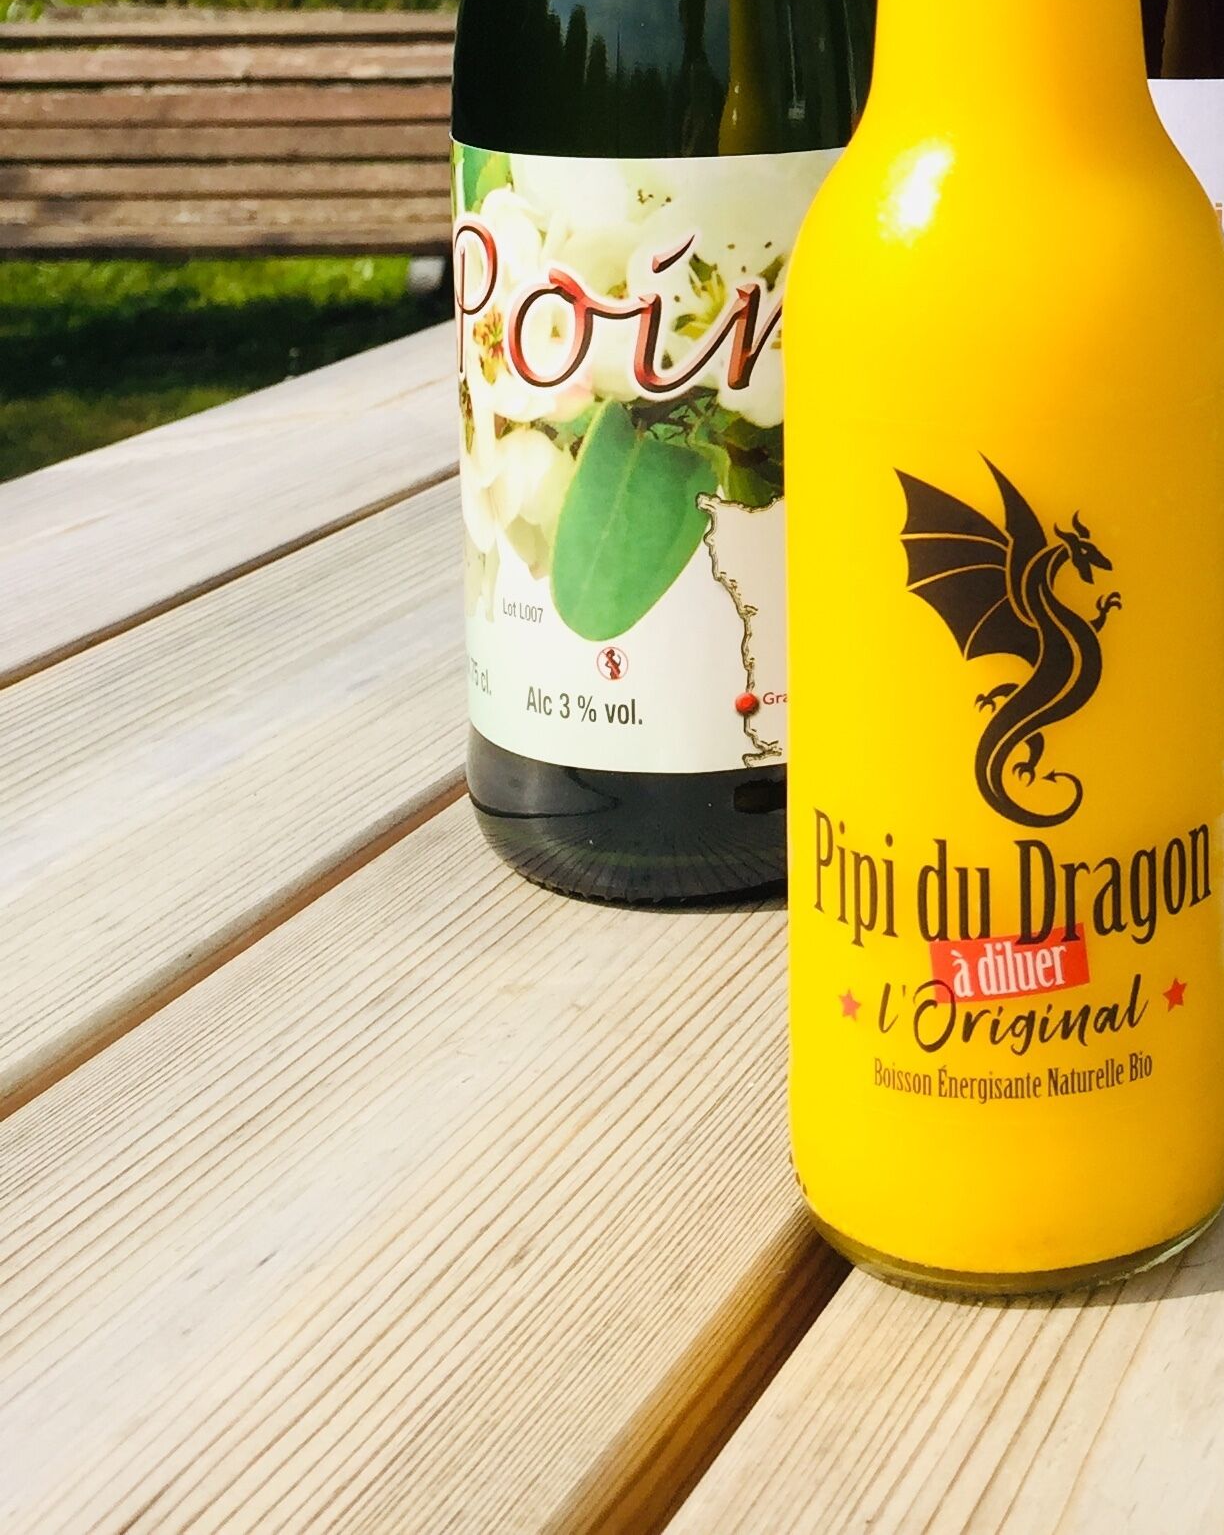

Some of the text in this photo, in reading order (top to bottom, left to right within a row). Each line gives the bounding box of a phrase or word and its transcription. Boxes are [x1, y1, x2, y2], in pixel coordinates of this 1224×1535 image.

[502, 597, 544, 624] Lot L007
[526, 686, 644, 726] Alc 3 % vol.
[813, 806, 1213, 950] Pipi du Dragon
[950, 940, 1068, 999] à diluer
[877, 972, 1150, 1057] l'Original
[873, 1051, 1154, 1105] Boisson Énergisante Naturelle Bio
